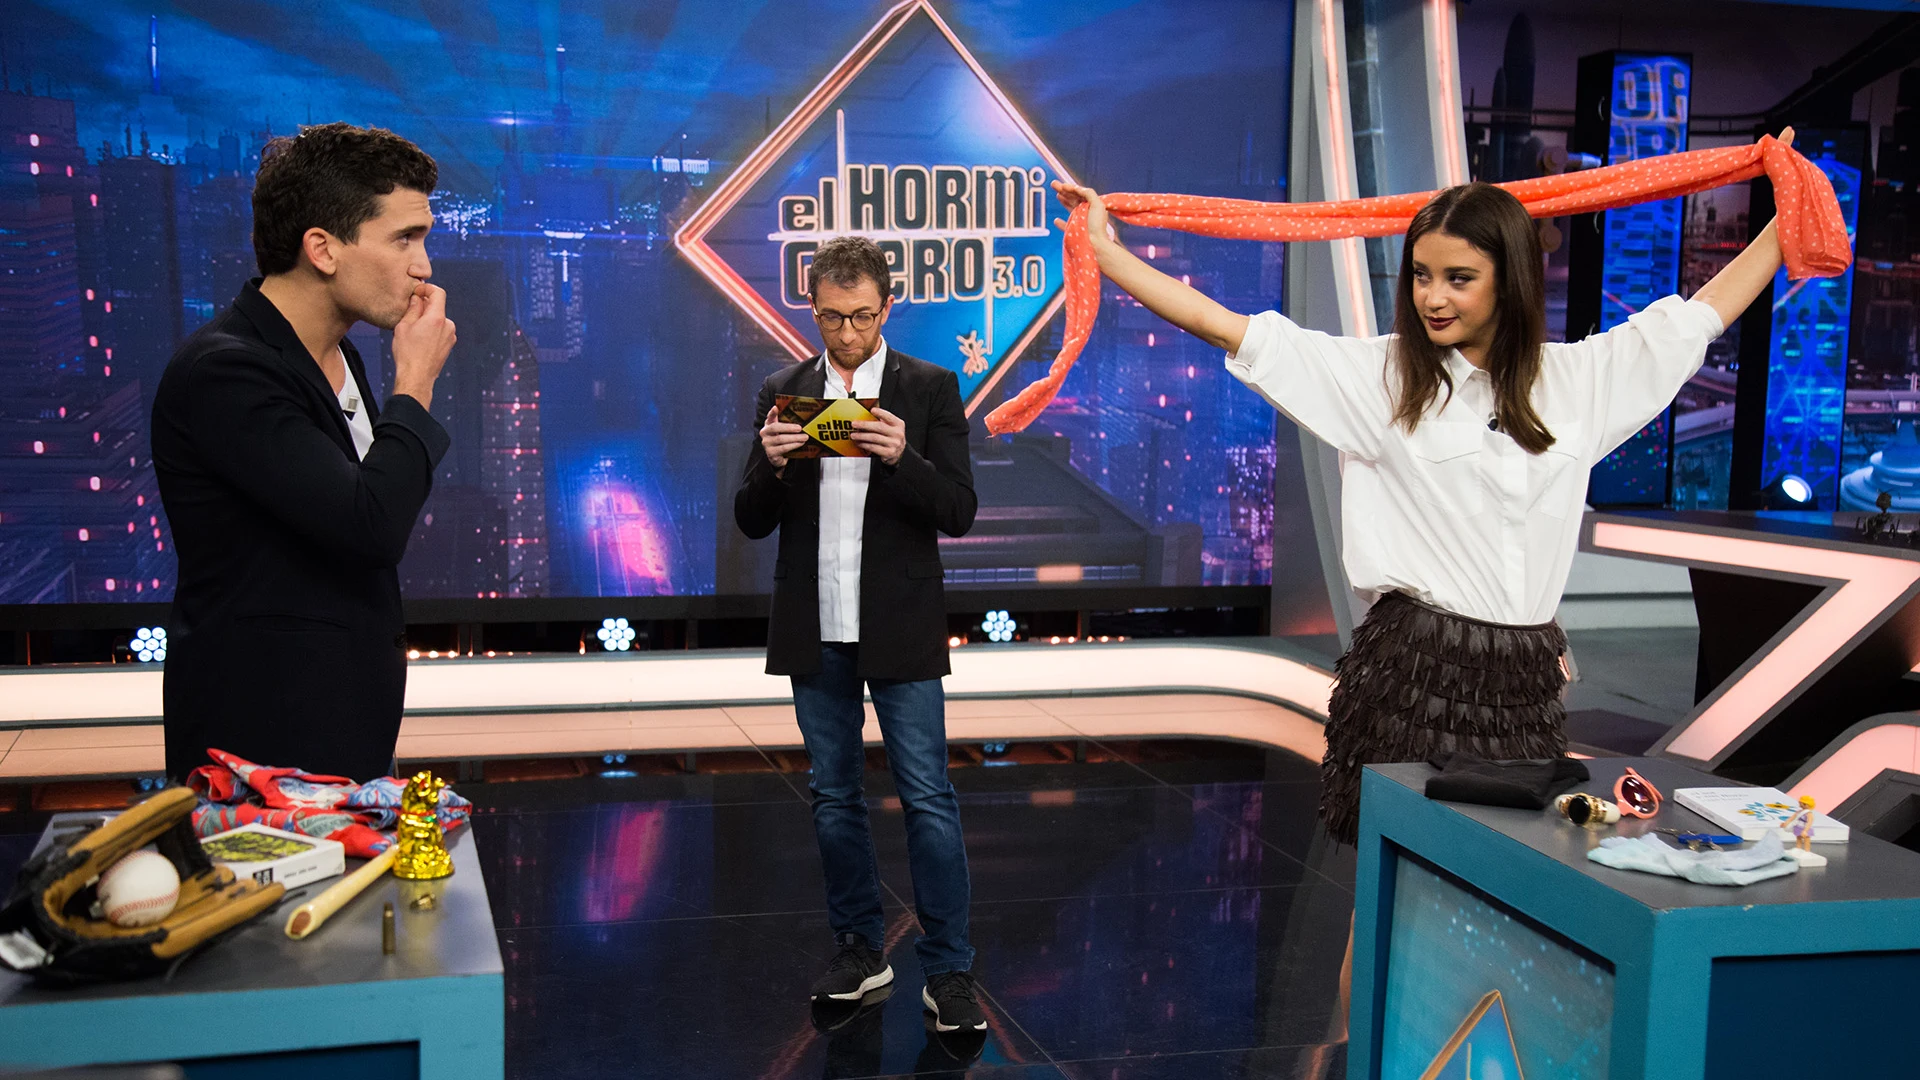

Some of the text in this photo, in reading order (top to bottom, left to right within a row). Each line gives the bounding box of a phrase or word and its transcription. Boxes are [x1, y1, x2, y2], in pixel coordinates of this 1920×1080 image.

[778, 177, 838, 233] el
[779, 238, 1047, 309] GeRO 3.0
[817, 419, 855, 431] el HO
[818, 430, 852, 441] GUe
